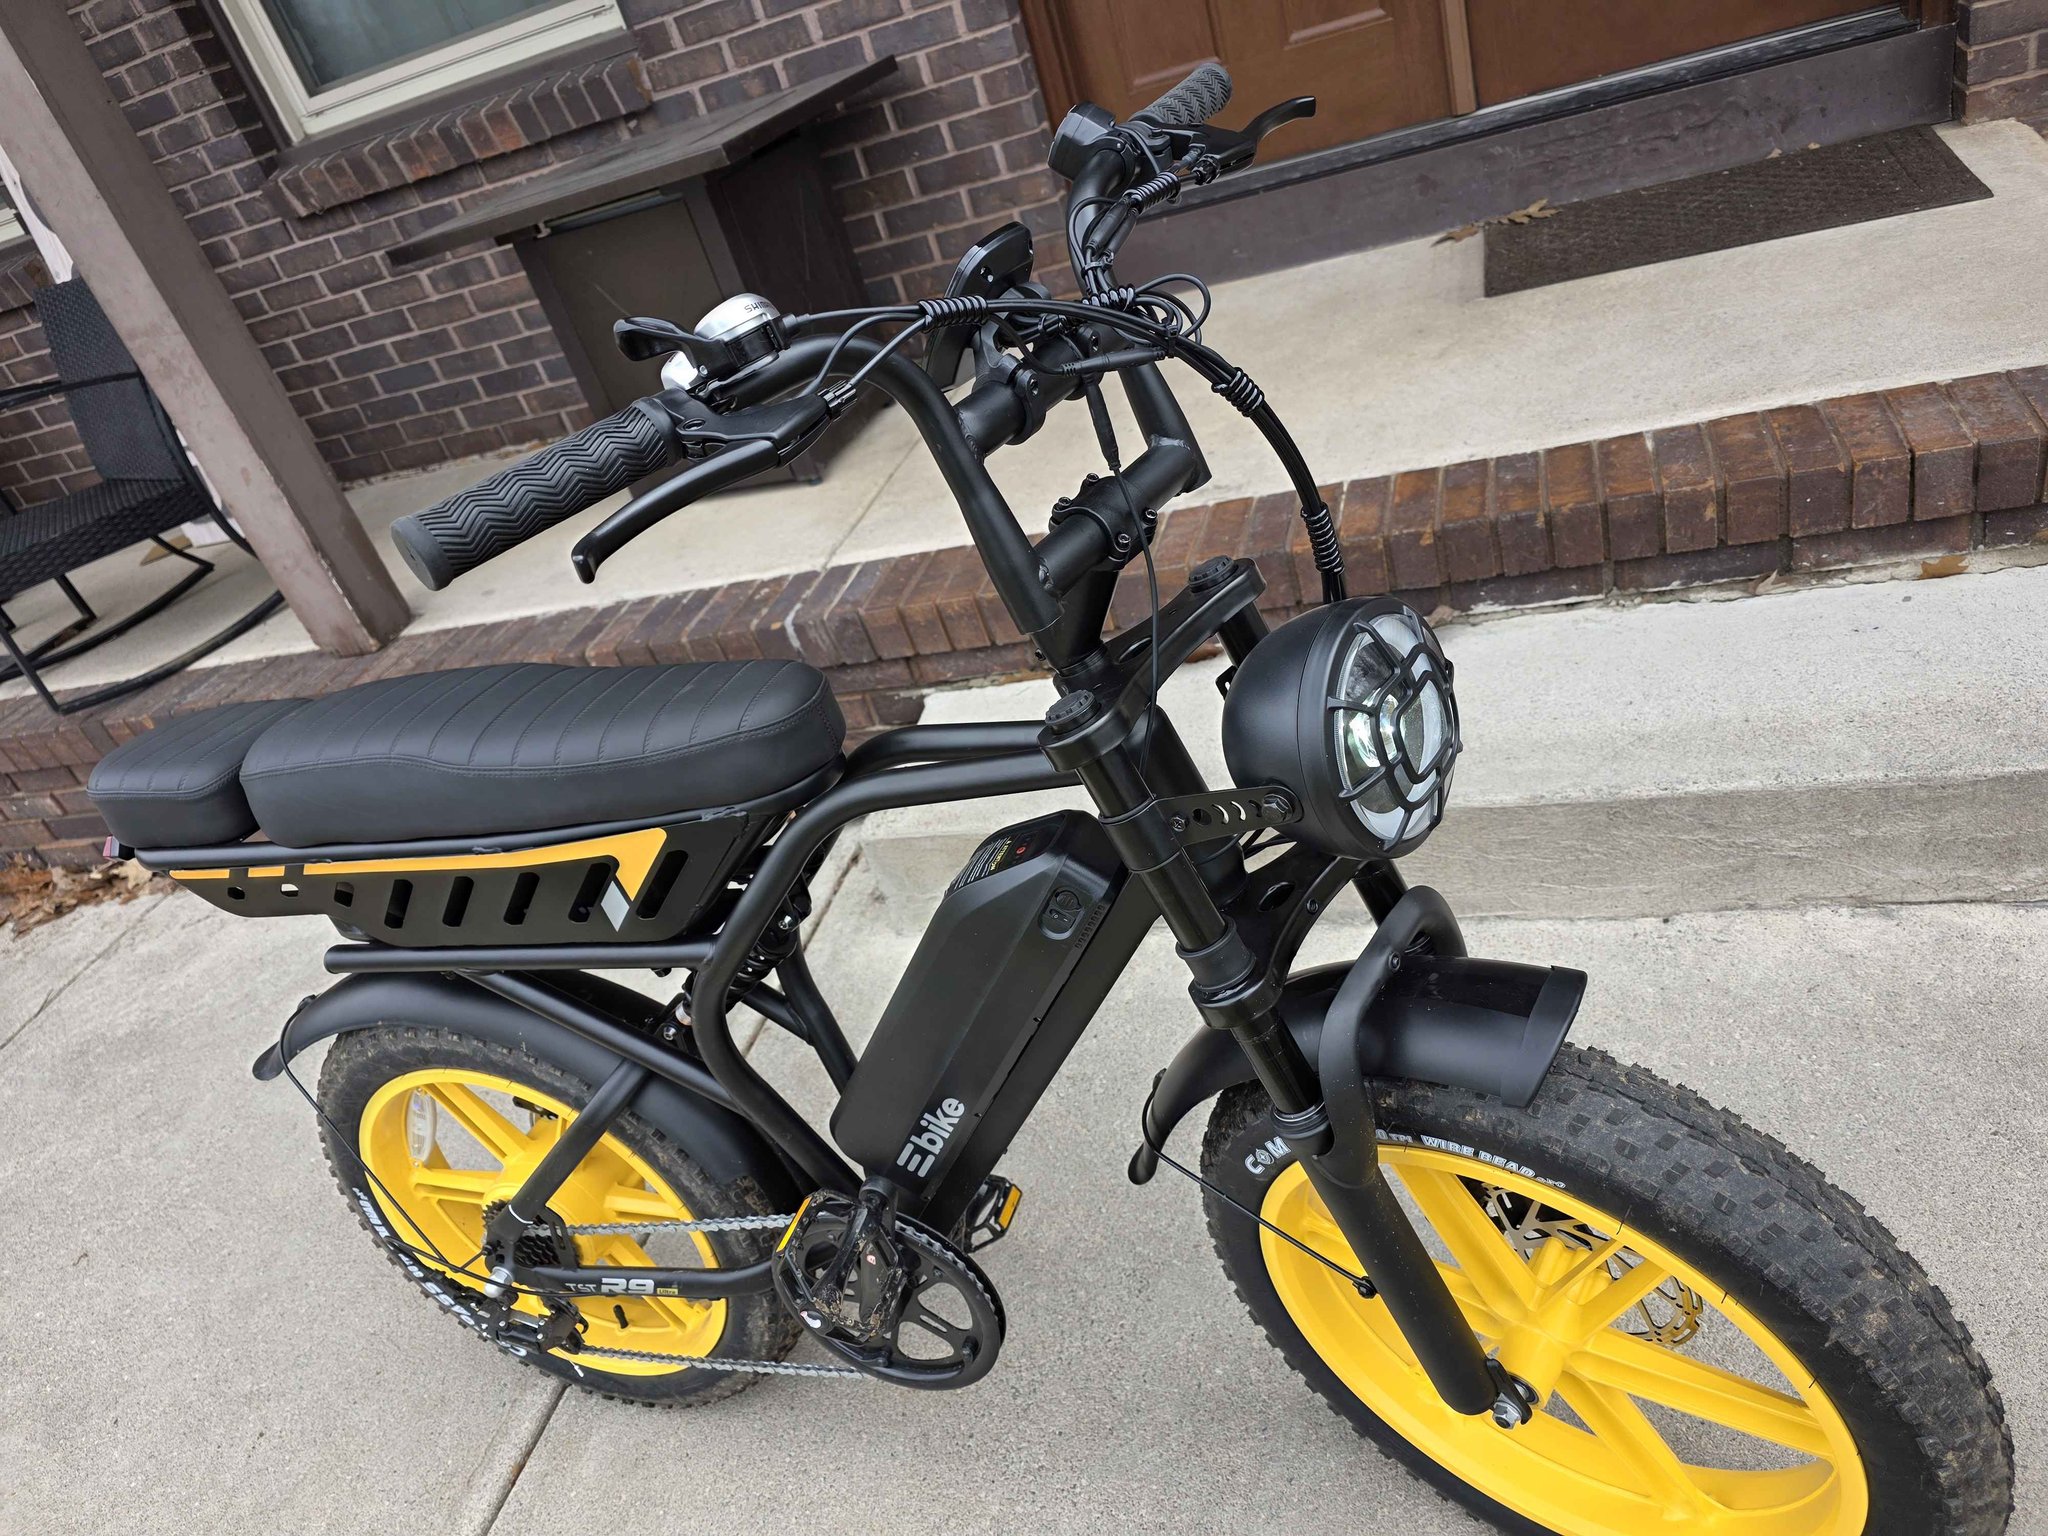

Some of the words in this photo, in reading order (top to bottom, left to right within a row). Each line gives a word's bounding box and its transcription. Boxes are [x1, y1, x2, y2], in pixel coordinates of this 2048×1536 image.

[896, 1097, 965, 1178] Ebike
[1420, 1134, 1475, 1157] WIRE
[1478, 1150, 1536, 1178] BEAD
[565, 1282, 597, 1293] TST
[600, 1277, 655, 1294] R9
